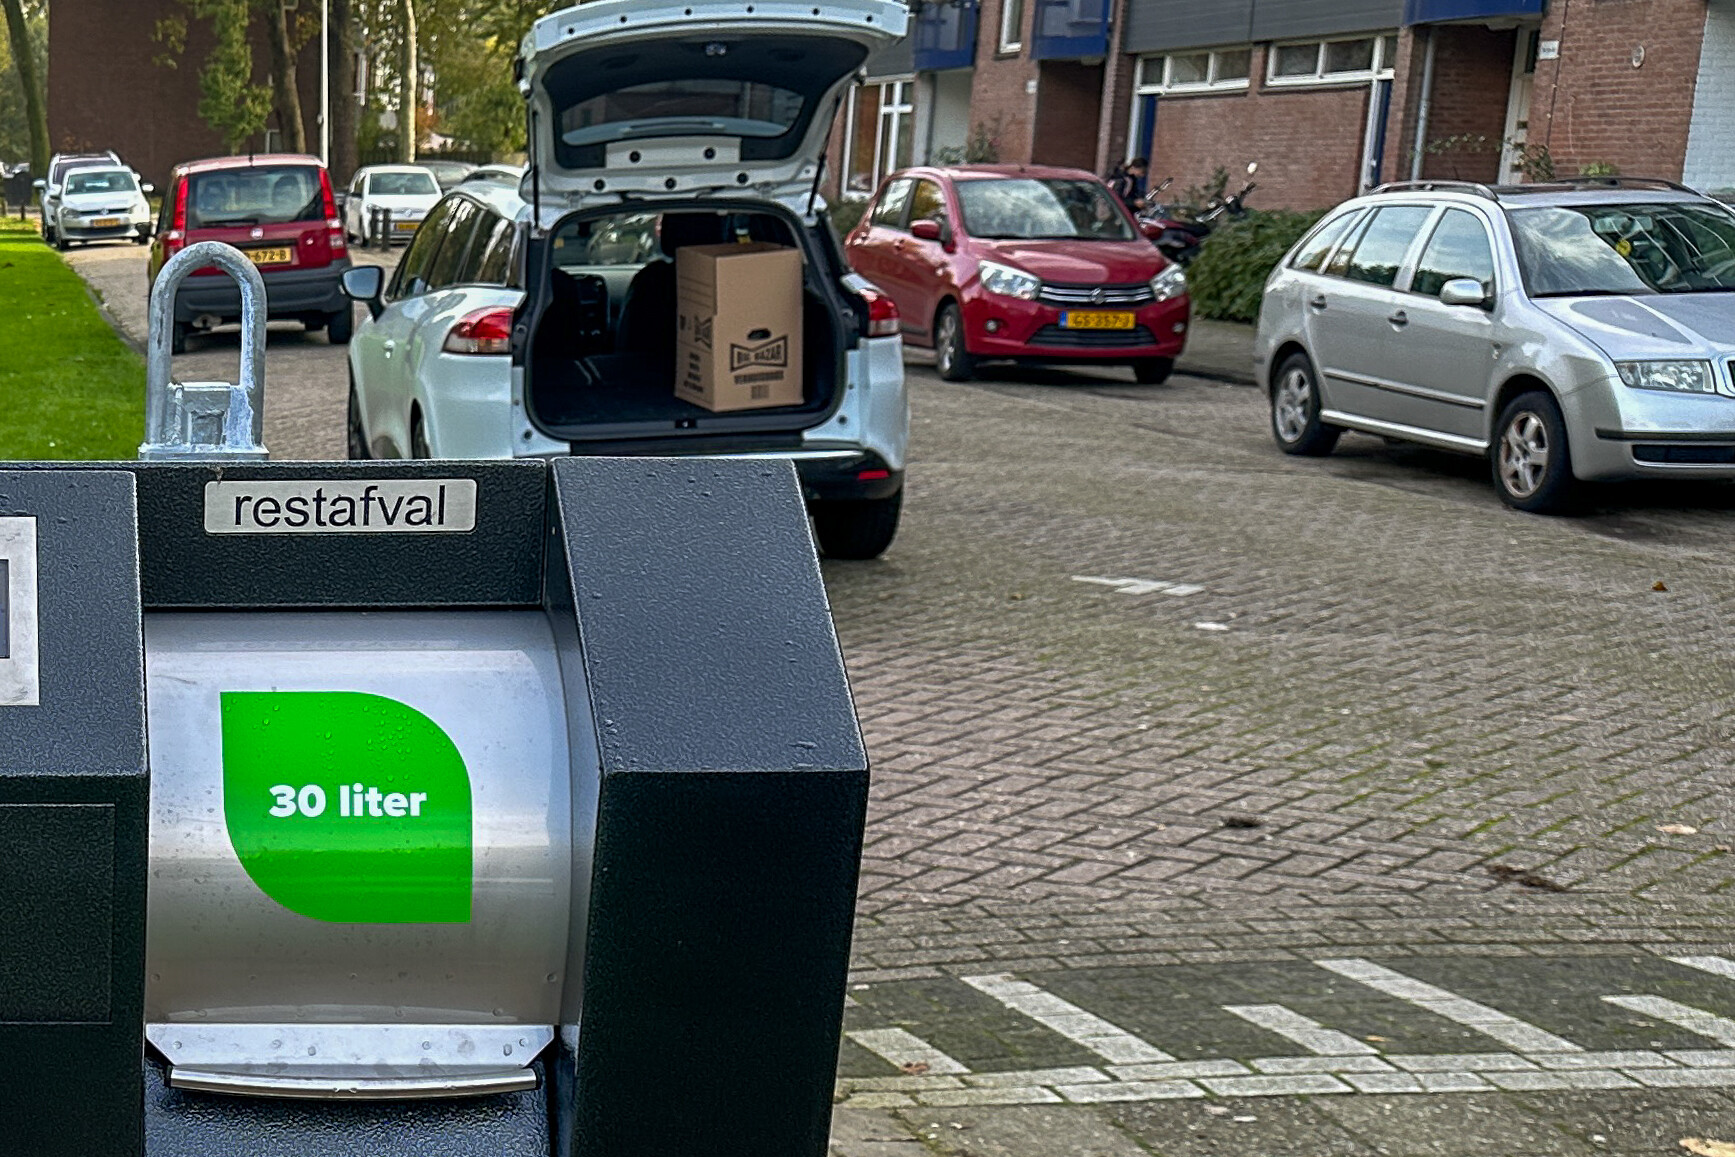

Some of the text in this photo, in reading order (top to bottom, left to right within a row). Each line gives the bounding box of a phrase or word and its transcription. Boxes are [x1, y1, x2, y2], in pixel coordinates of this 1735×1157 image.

[754, 344, 782, 361] BAZAR
[235, 485, 446, 526] restafval
[269, 783, 427, 818] 30 liter
